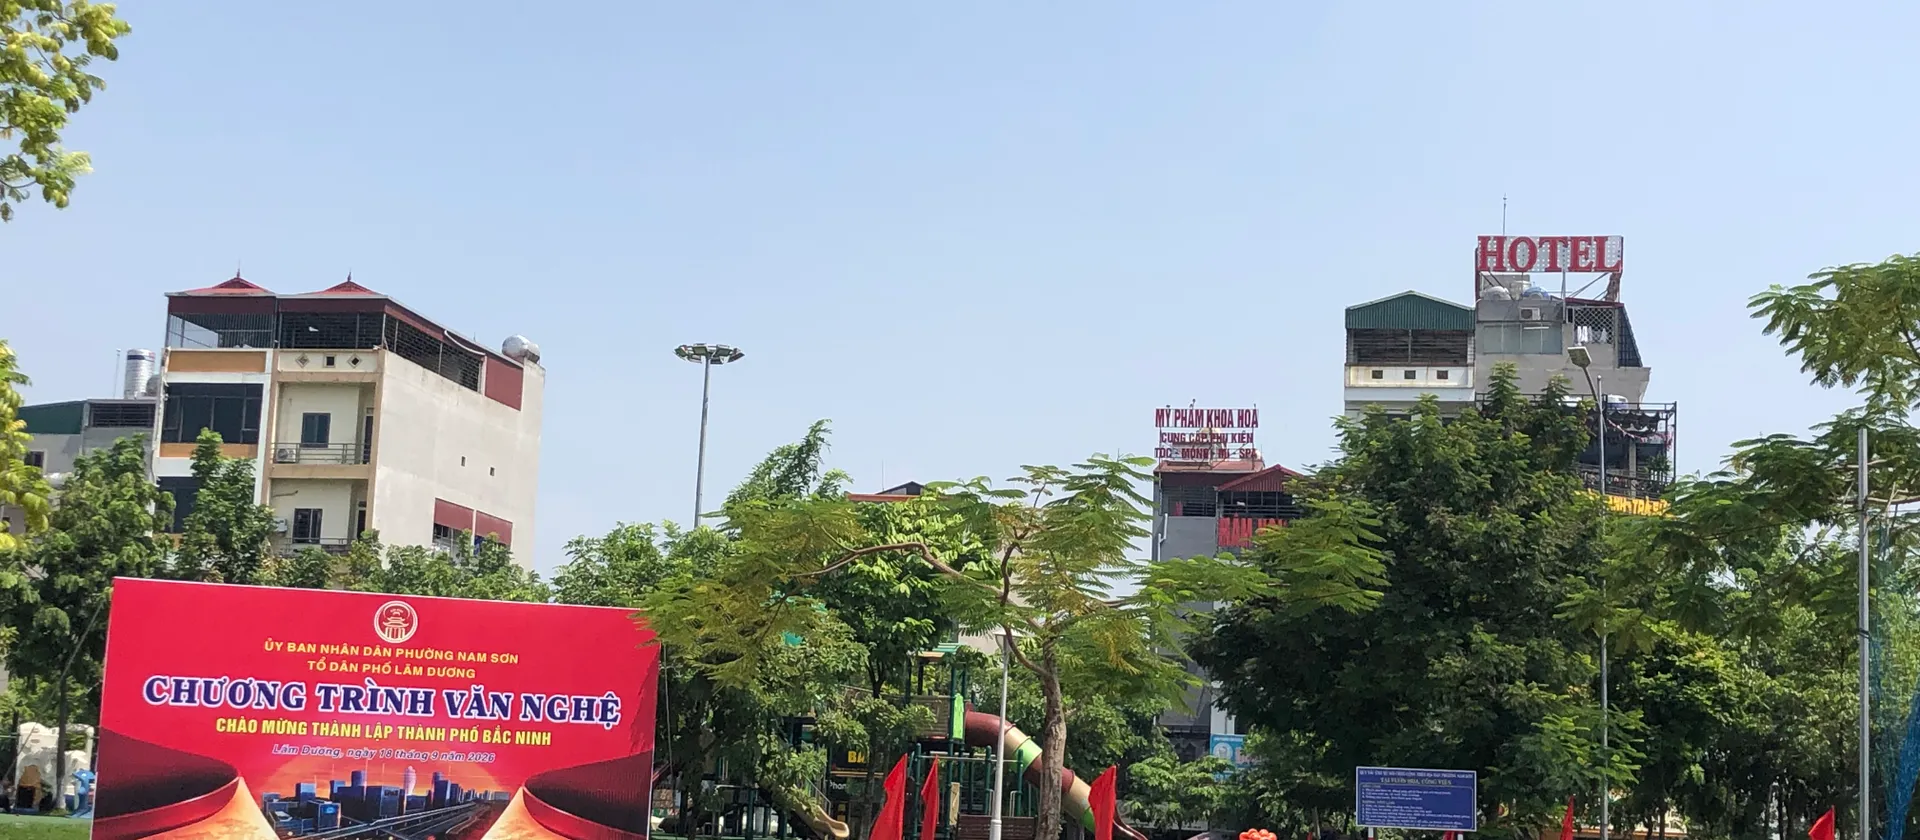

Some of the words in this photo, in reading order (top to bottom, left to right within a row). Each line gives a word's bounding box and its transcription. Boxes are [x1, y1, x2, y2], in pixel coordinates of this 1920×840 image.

[1477, 235, 1622, 273] HOTEL
[1206, 408, 1234, 428] KHOA
[1161, 432, 1186, 443] CUNG
[1239, 447, 1257, 459] SPA
[264, 637, 284, 652] ỦY
[287, 642, 317, 653] BAN
[320, 643, 359, 656] NHÂN
[363, 644, 392, 658] DÂN
[396, 648, 454, 661] PHƯỜNG
[457, 651, 487, 662] NAM
[490, 652, 519, 664] SƠN
[307, 656, 327, 671] TỔ
[329, 660, 358, 673] DÂN
[362, 661, 392, 675] PHỐ
[427, 665, 476, 679] DƯƠNG
[144, 675, 306, 709] CHƯƠNG
[316, 677, 434, 716] TRÌNH
[443, 685, 513, 721] VĂN
[520, 691, 622, 730] NGHỆ
[216, 717, 258, 734] CHÀO
[261, 717, 308, 736] MỪNG
[312, 719, 361, 738] THÀNH
[365, 721, 393, 741] LẬP
[397, 723, 446, 743] THÀNH
[449, 724, 480, 744] PHỐ
[482, 724, 512, 745] BẮC
[514, 730, 552, 746] NINH
[346, 747, 377, 760] ngày
[379, 748, 392, 758] 18
[395, 749, 430, 762] tháng
[431, 750, 439, 760] 9
[440, 750, 465, 762] năm
[467, 752, 496, 763] 2026
